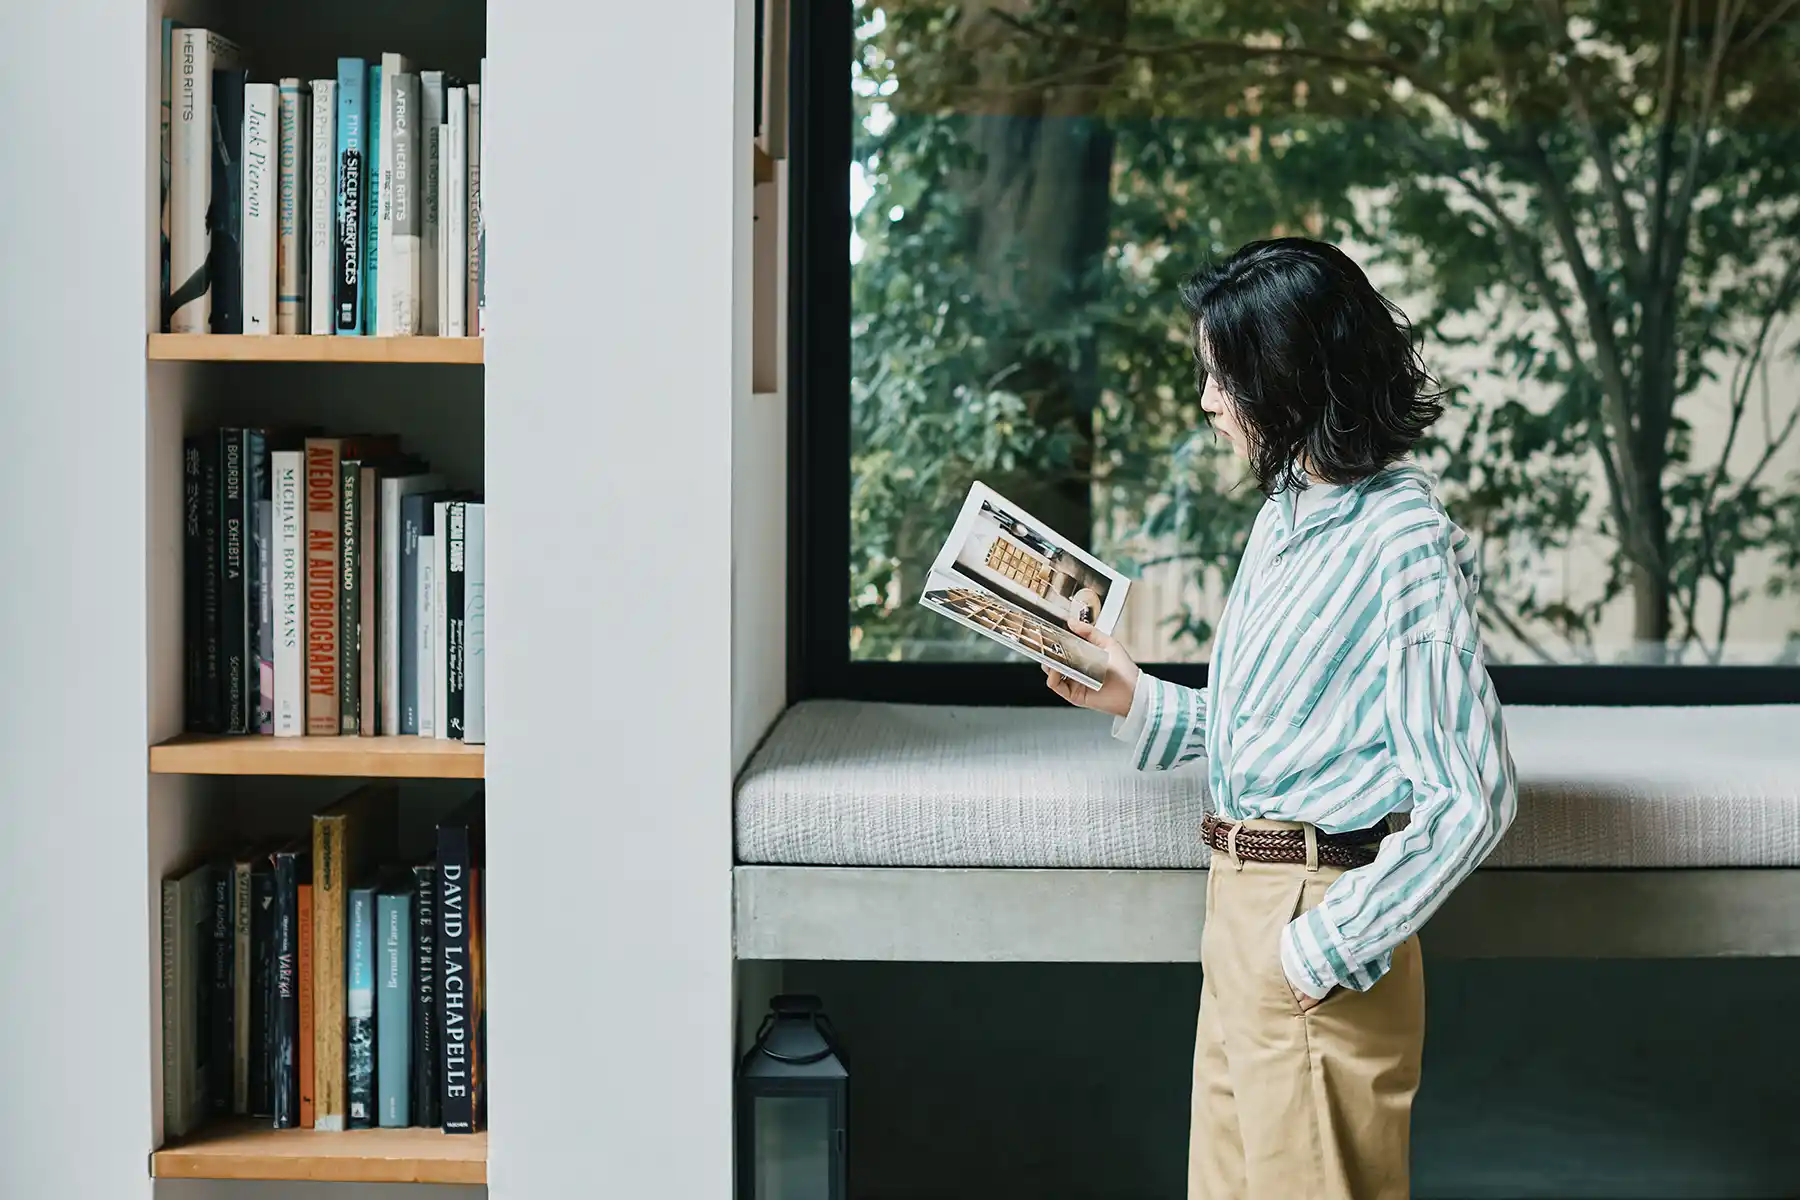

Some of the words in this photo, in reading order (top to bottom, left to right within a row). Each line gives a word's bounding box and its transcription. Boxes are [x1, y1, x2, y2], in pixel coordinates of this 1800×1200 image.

[183, 33, 194, 75] HERB
[182, 77, 193, 121] RITTS
[249, 103, 267, 146] Jack
[315, 83, 329, 149] GRAPHIS
[346, 114, 358, 135] FIN
[395, 88, 407, 136] AFRICA
[281, 99, 294, 167] EDWARD
[346, 138, 358, 156] DE
[248, 149, 268, 218] Pierson
[396, 143, 406, 180] HERB
[281, 172, 295, 237] HOPPER
[396, 184, 406, 221] RITTS
[343, 199, 358, 284] MASTERPIECES
[227, 445, 239, 499] BOURDIN
[309, 447, 334, 512] AVEDON
[283, 468, 297, 542] MICHAËL
[228, 518, 239, 567] EXHIBIT
[309, 529, 335, 551] AN
[229, 569, 239, 579] A
[283, 548, 296, 648] BORREMANS
[309, 558, 335, 696] AUTOBIOGRAPHY
[420, 879, 432, 926] ALICE
[443, 863, 462, 937] DAVID
[419, 936, 433, 1004] SPRINGS
[445, 945, 466, 1099] LACHAPELLE
